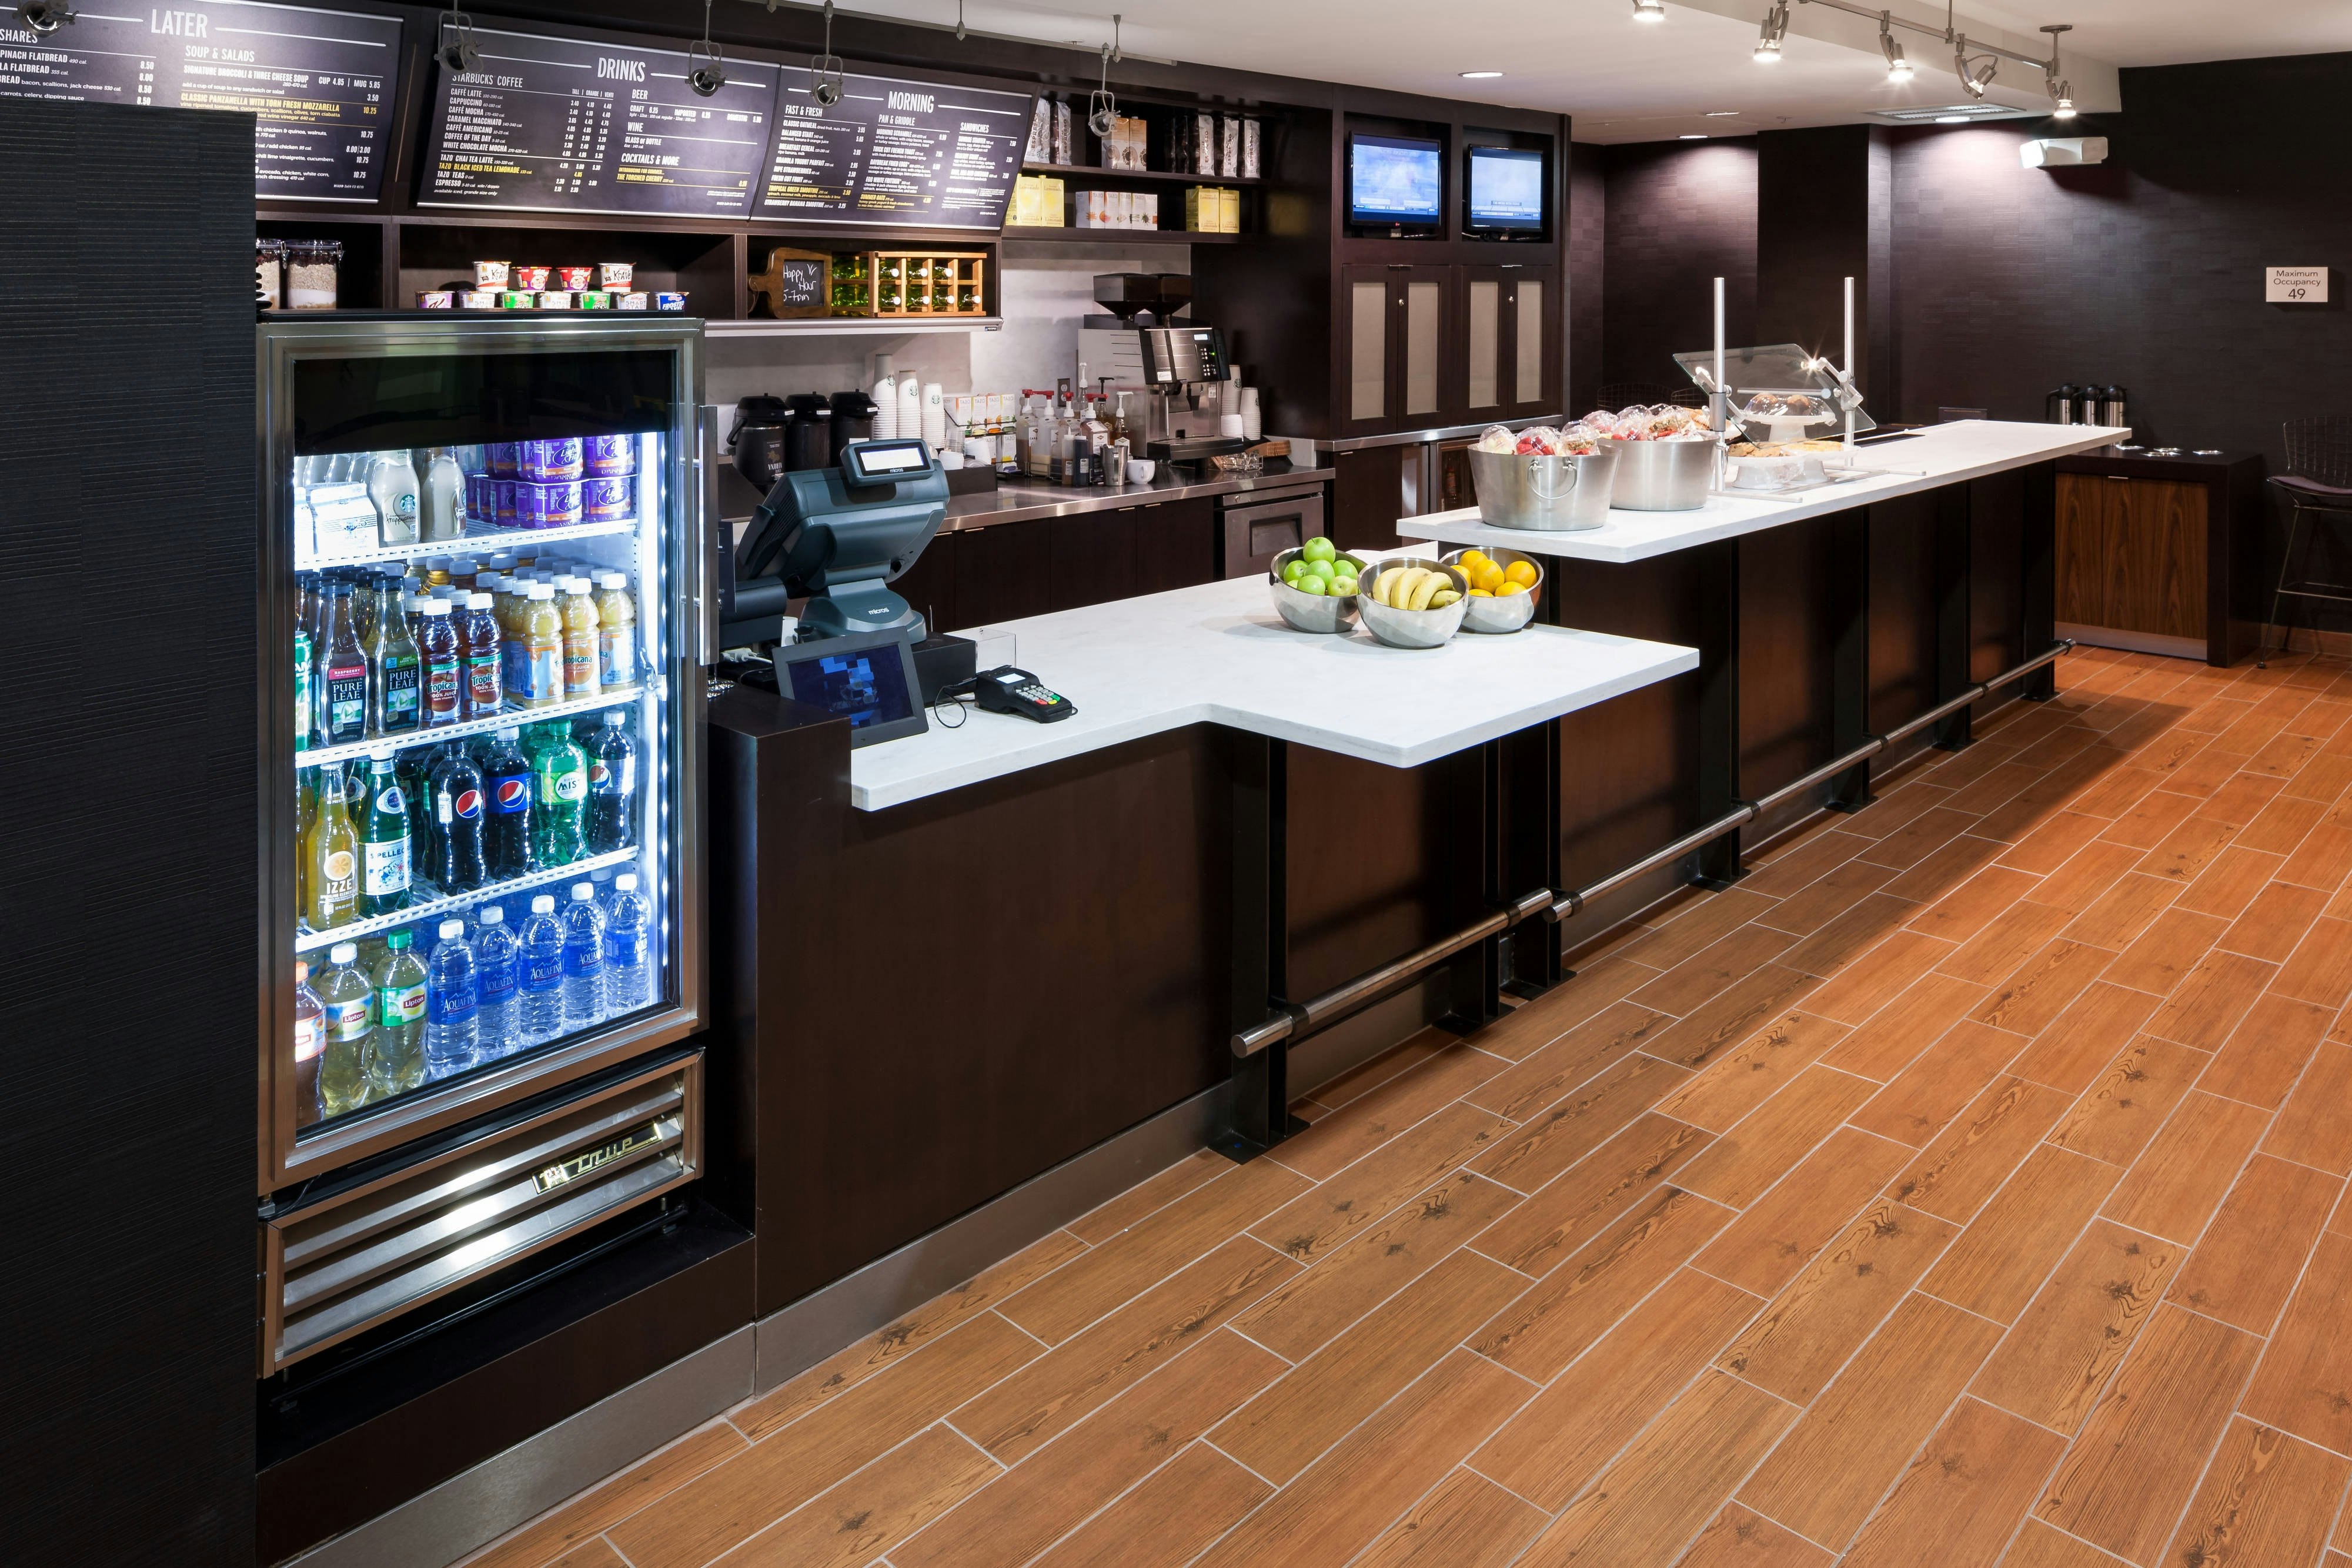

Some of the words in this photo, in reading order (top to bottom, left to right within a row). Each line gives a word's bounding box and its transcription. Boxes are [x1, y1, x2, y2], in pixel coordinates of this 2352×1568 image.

[151, 9, 208, 38] LATER
[29, 52, 68, 63] FLATBREAD
[185, 45, 209, 58] SOUP
[212, 48, 218, 59] &
[221, 48, 255, 62] SALADS
[10, 63, 49, 74] FLATBREAD
[140, 61, 155, 71] 8.50
[597, 57, 646, 82] DRINKS
[139, 73, 153, 82] 8.00
[183, 65, 217, 76] SIGNATURE
[218, 68, 247, 78] BROCCOLI
[253, 71, 271, 80] THREE
[272, 72, 293, 82] CHEESE
[293, 73, 309, 83] SOUP
[318, 76, 330, 85] CUP
[332, 78, 345, 86] 4.85
[353, 79, 367, 88] MUG
[452, 72, 493, 85] STARBUCKS
[497, 75, 523, 88] COFFEE
[138, 85, 153, 94] 8.50
[450, 88, 466, 96] CAFFÈ
[467, 89, 482, 98] LATTE
[632, 89, 648, 100] BEER
[136, 96, 151, 105] 8.50
[181, 92, 208, 102] CLASSIC
[209, 95, 248, 105] PANZANELLA
[249, 98, 265, 106] WITH
[266, 99, 282, 108] TORN
[283, 99, 302, 109] FRESH
[303, 101, 339, 112] MOZZARELLA
[367, 93, 379, 102] 3.50
[449, 97, 482, 106] CAPPUCCINO
[888, 91, 934, 113] MORNING
[363, 106, 377, 115] 10.25
[448, 106, 464, 114] CAFFÈ
[465, 108, 484, 116] MOCHA
[630, 105, 644, 113] CRAFT
[785, 105, 800, 115] FAST
[800, 106, 804, 116] &
[805, 106, 823, 117] FRESH
[447, 115, 471, 123] CARAMEL
[472, 117, 502, 126] MACCHIATO
[878, 114, 889, 123] PAN
[890, 115, 894, 124] &
[894, 116, 916, 126] GRIDDLE
[446, 123, 462, 132] CAFFÈ
[462, 125, 493, 134] AMERICANO
[627, 122, 644, 133] WINE
[960, 122, 990, 133] SANDWICHES
[360, 131, 373, 139] 10.75
[445, 132, 463, 141] COFFEE
[443, 141, 459, 149] WHITE
[460, 143, 488, 151] CHOCOLATE
[624, 136, 639, 144] GLASS
[646, 138, 662, 146] BOTTLE
[356, 156, 369, 164] 10.75
[440, 153, 453, 162] TAZO
[621, 153, 654, 165] COCKTAILS
[655, 155, 661, 165] &
[662, 156, 680, 166] MORE
[453, 163, 470, 171] BLACK
[493, 166, 520, 174] LEMONADE
[783, 265, 803, 283] Happy
[799, 278, 816, 291] Hour
[2273, 278, 2321, 287] Occupancy
[2288, 288, 2306, 299] 49
[389, 669, 416, 681] PURE
[333, 682, 363, 693] PURE
[558, 780, 577, 791] MIS
[326, 879, 352, 894] IZZE
[530, 961, 563, 980] AQUAFINA
[485, 974, 513, 992] AQUAFIN
[405, 995, 425, 1008] Lipton
[343, 1011, 364, 1023] Lipton
